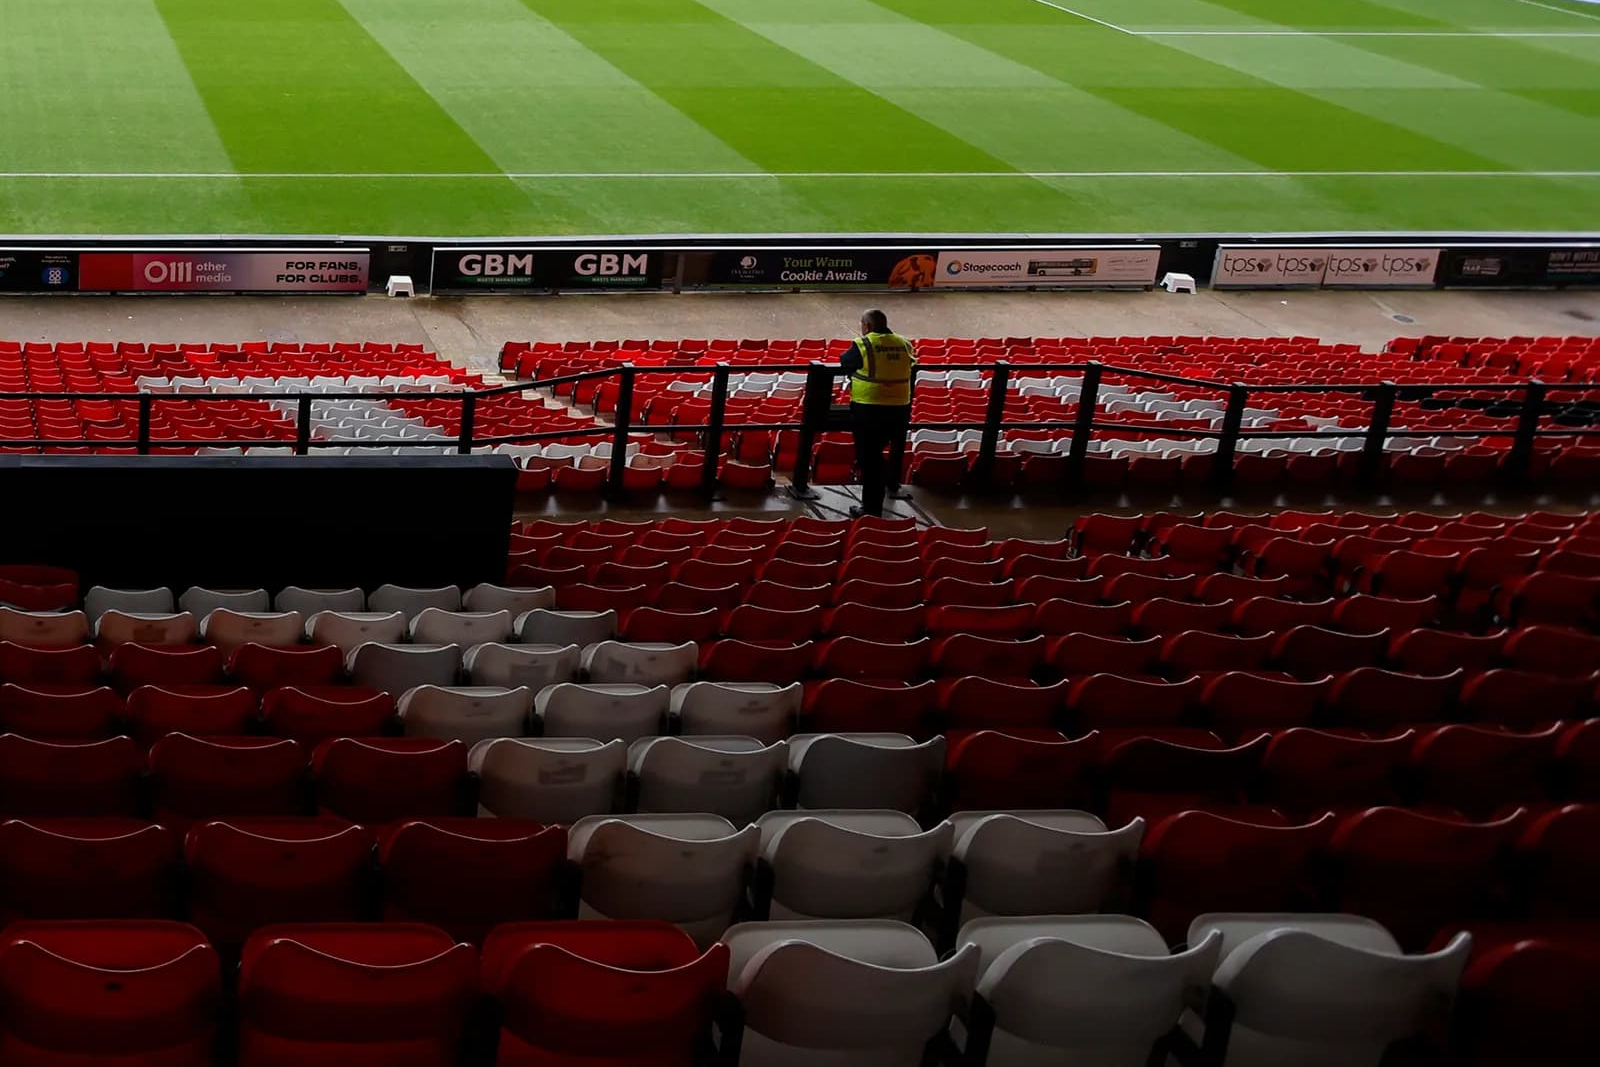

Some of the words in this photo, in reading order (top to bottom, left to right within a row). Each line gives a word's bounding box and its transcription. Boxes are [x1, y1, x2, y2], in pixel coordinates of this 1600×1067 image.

[196, 261, 227, 272] other
[286, 261, 317, 272] FOR
[319, 261, 362, 273] FANS,
[458, 253, 534, 276] GBM
[574, 253, 648, 276] GBM
[783, 256, 812, 268] Your
[815, 256, 853, 268] Warm
[962, 261, 1022, 274] Stagecoach
[1223, 254, 1256, 276] tps
[1276, 254, 1309, 276] tps
[1329, 254, 1362, 276] tps
[1382, 254, 1416, 276] tps
[196, 272, 232, 283] media
[276, 273, 307, 284] FOR
[780, 269, 824, 282] Cookie
[825, 269, 868, 282] Awaits
